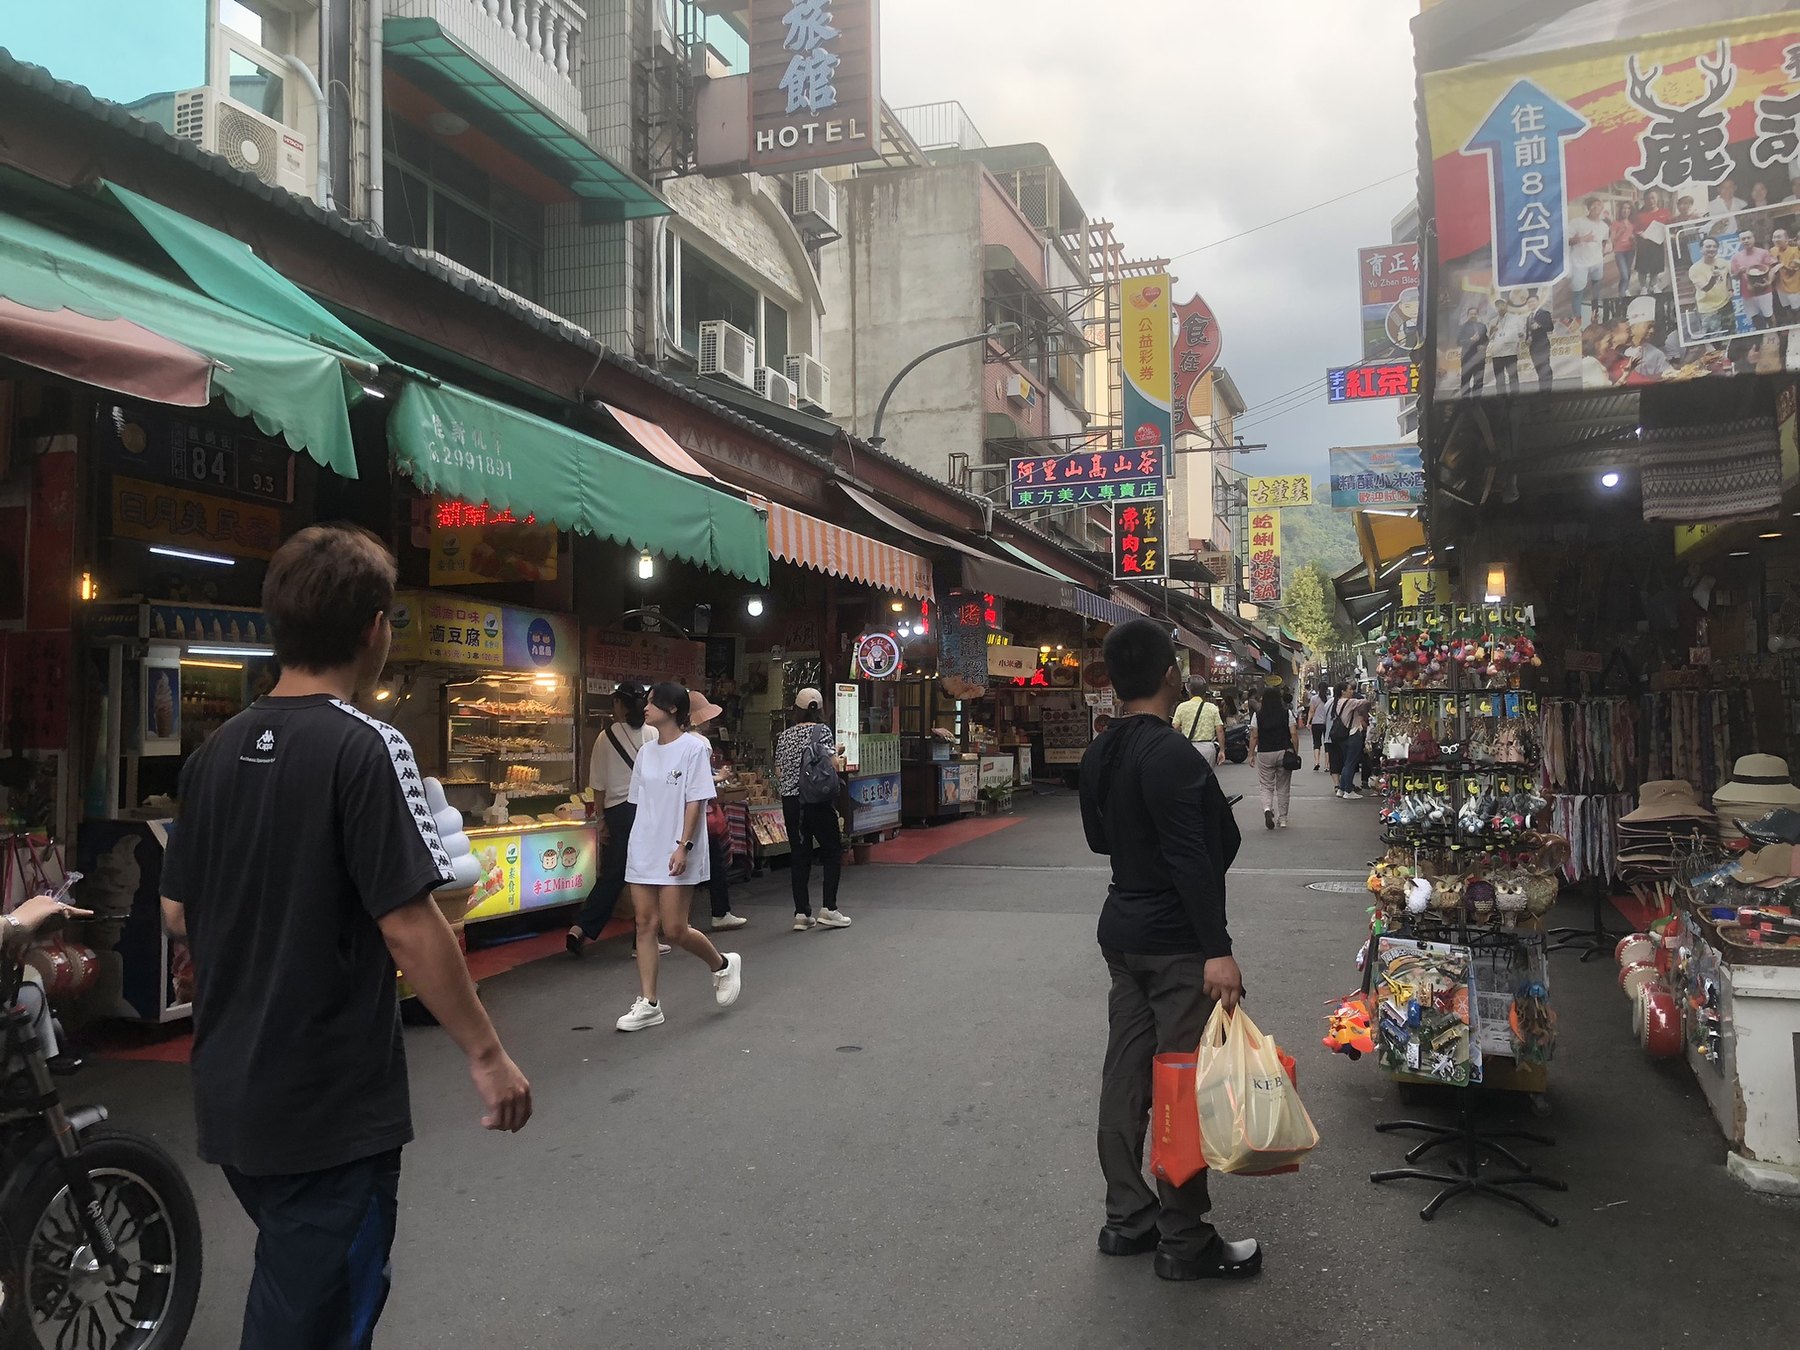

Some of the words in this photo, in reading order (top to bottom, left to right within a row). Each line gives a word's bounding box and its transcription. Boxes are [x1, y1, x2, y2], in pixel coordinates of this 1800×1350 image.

[779, 0, 842, 117] 旅館
[756, 118, 866, 152] HOTEL
[1510, 103, 1553, 268] 往前8公尺
[1138, 317, 1155, 381] 公益彩券
[1330, 370, 1345, 401] 手工
[1346, 364, 1408, 398] 紅茶
[191, 446, 228, 484] 84
[1017, 450, 1158, 484] 阿里山高山茶
[1018, 481, 1158, 506] 東方美人專賣店
[436, 501, 536, 529] 湖南
[1141, 506, 1158, 572] 第一名
[1252, 513, 1276, 600] 蛤蜊啵啵鍋
